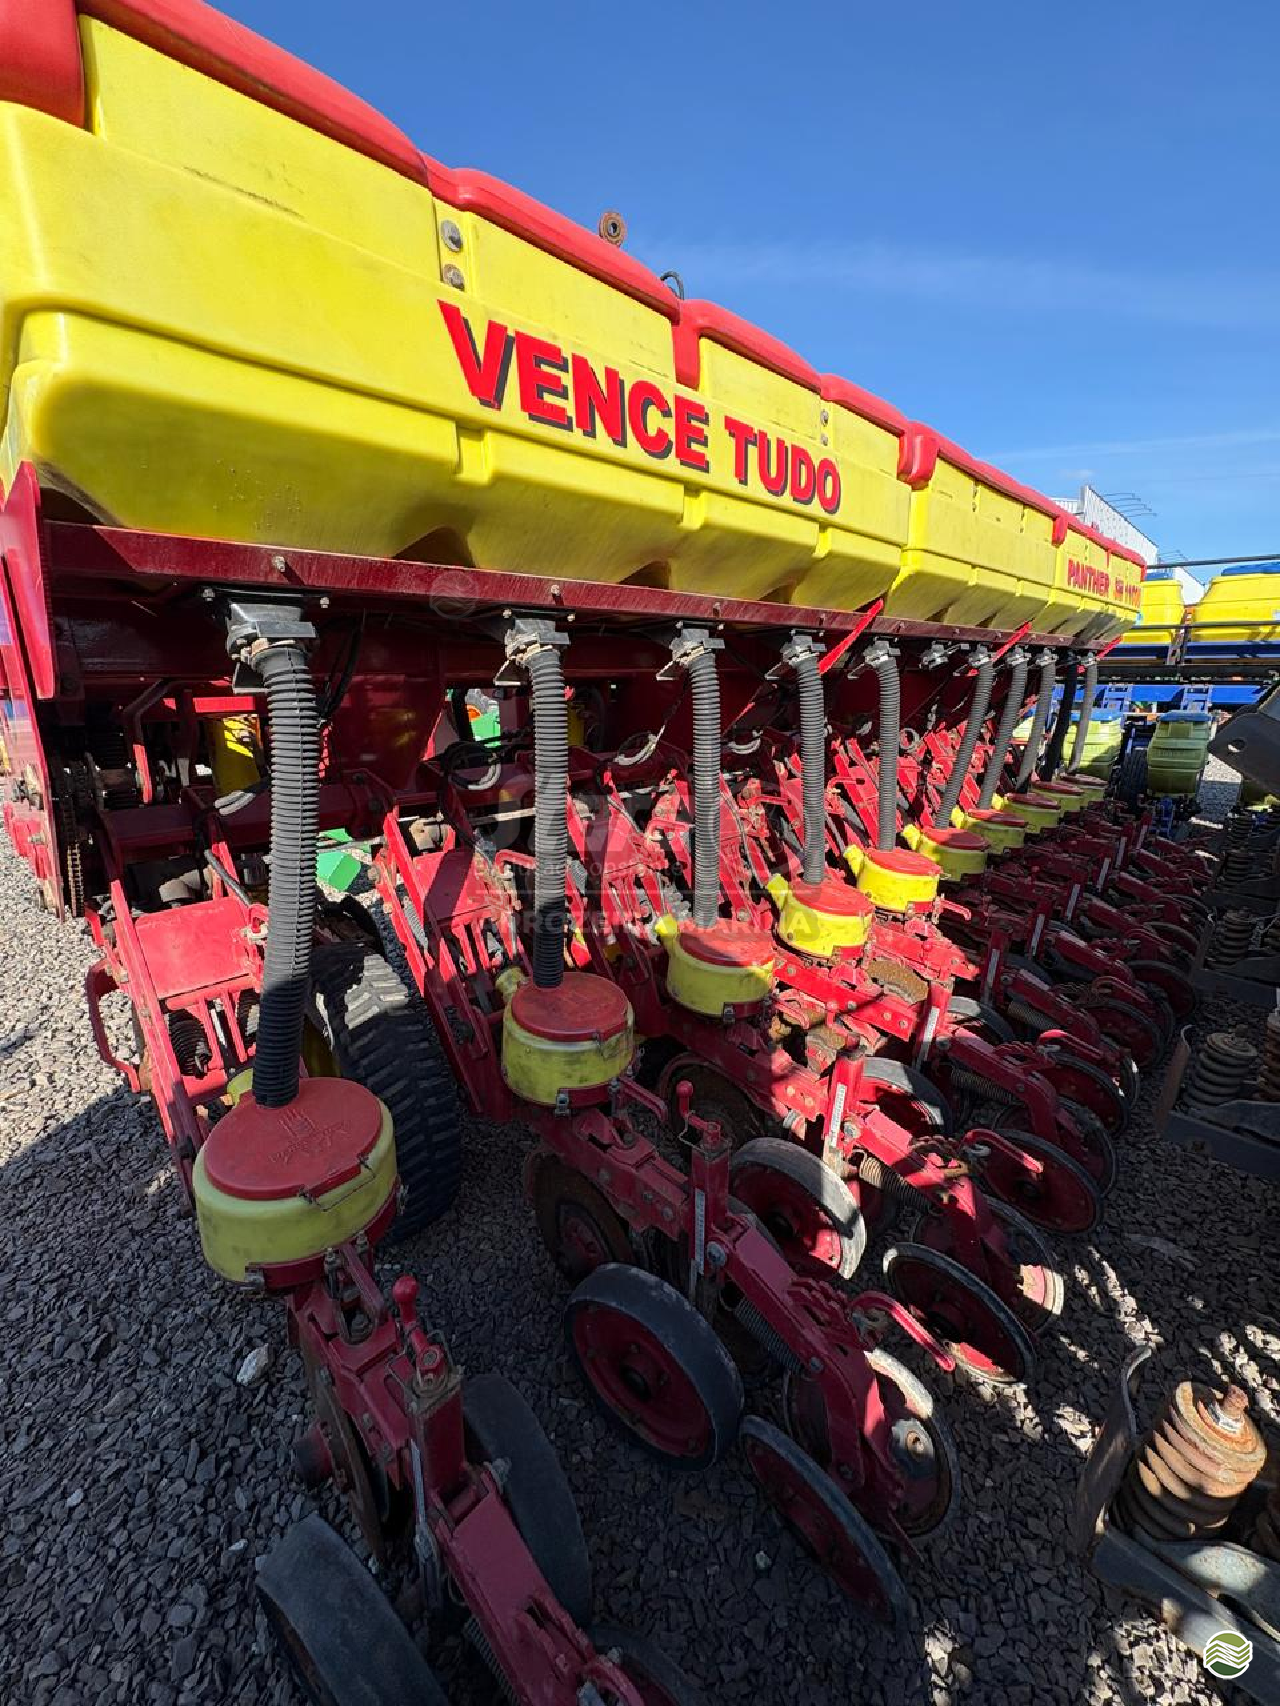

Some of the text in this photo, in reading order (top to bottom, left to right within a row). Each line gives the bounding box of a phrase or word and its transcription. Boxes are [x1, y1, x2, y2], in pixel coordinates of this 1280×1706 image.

[437, 300, 841, 514] VENCE TUDO
[1067, 558, 1109, 597] PANTHER
